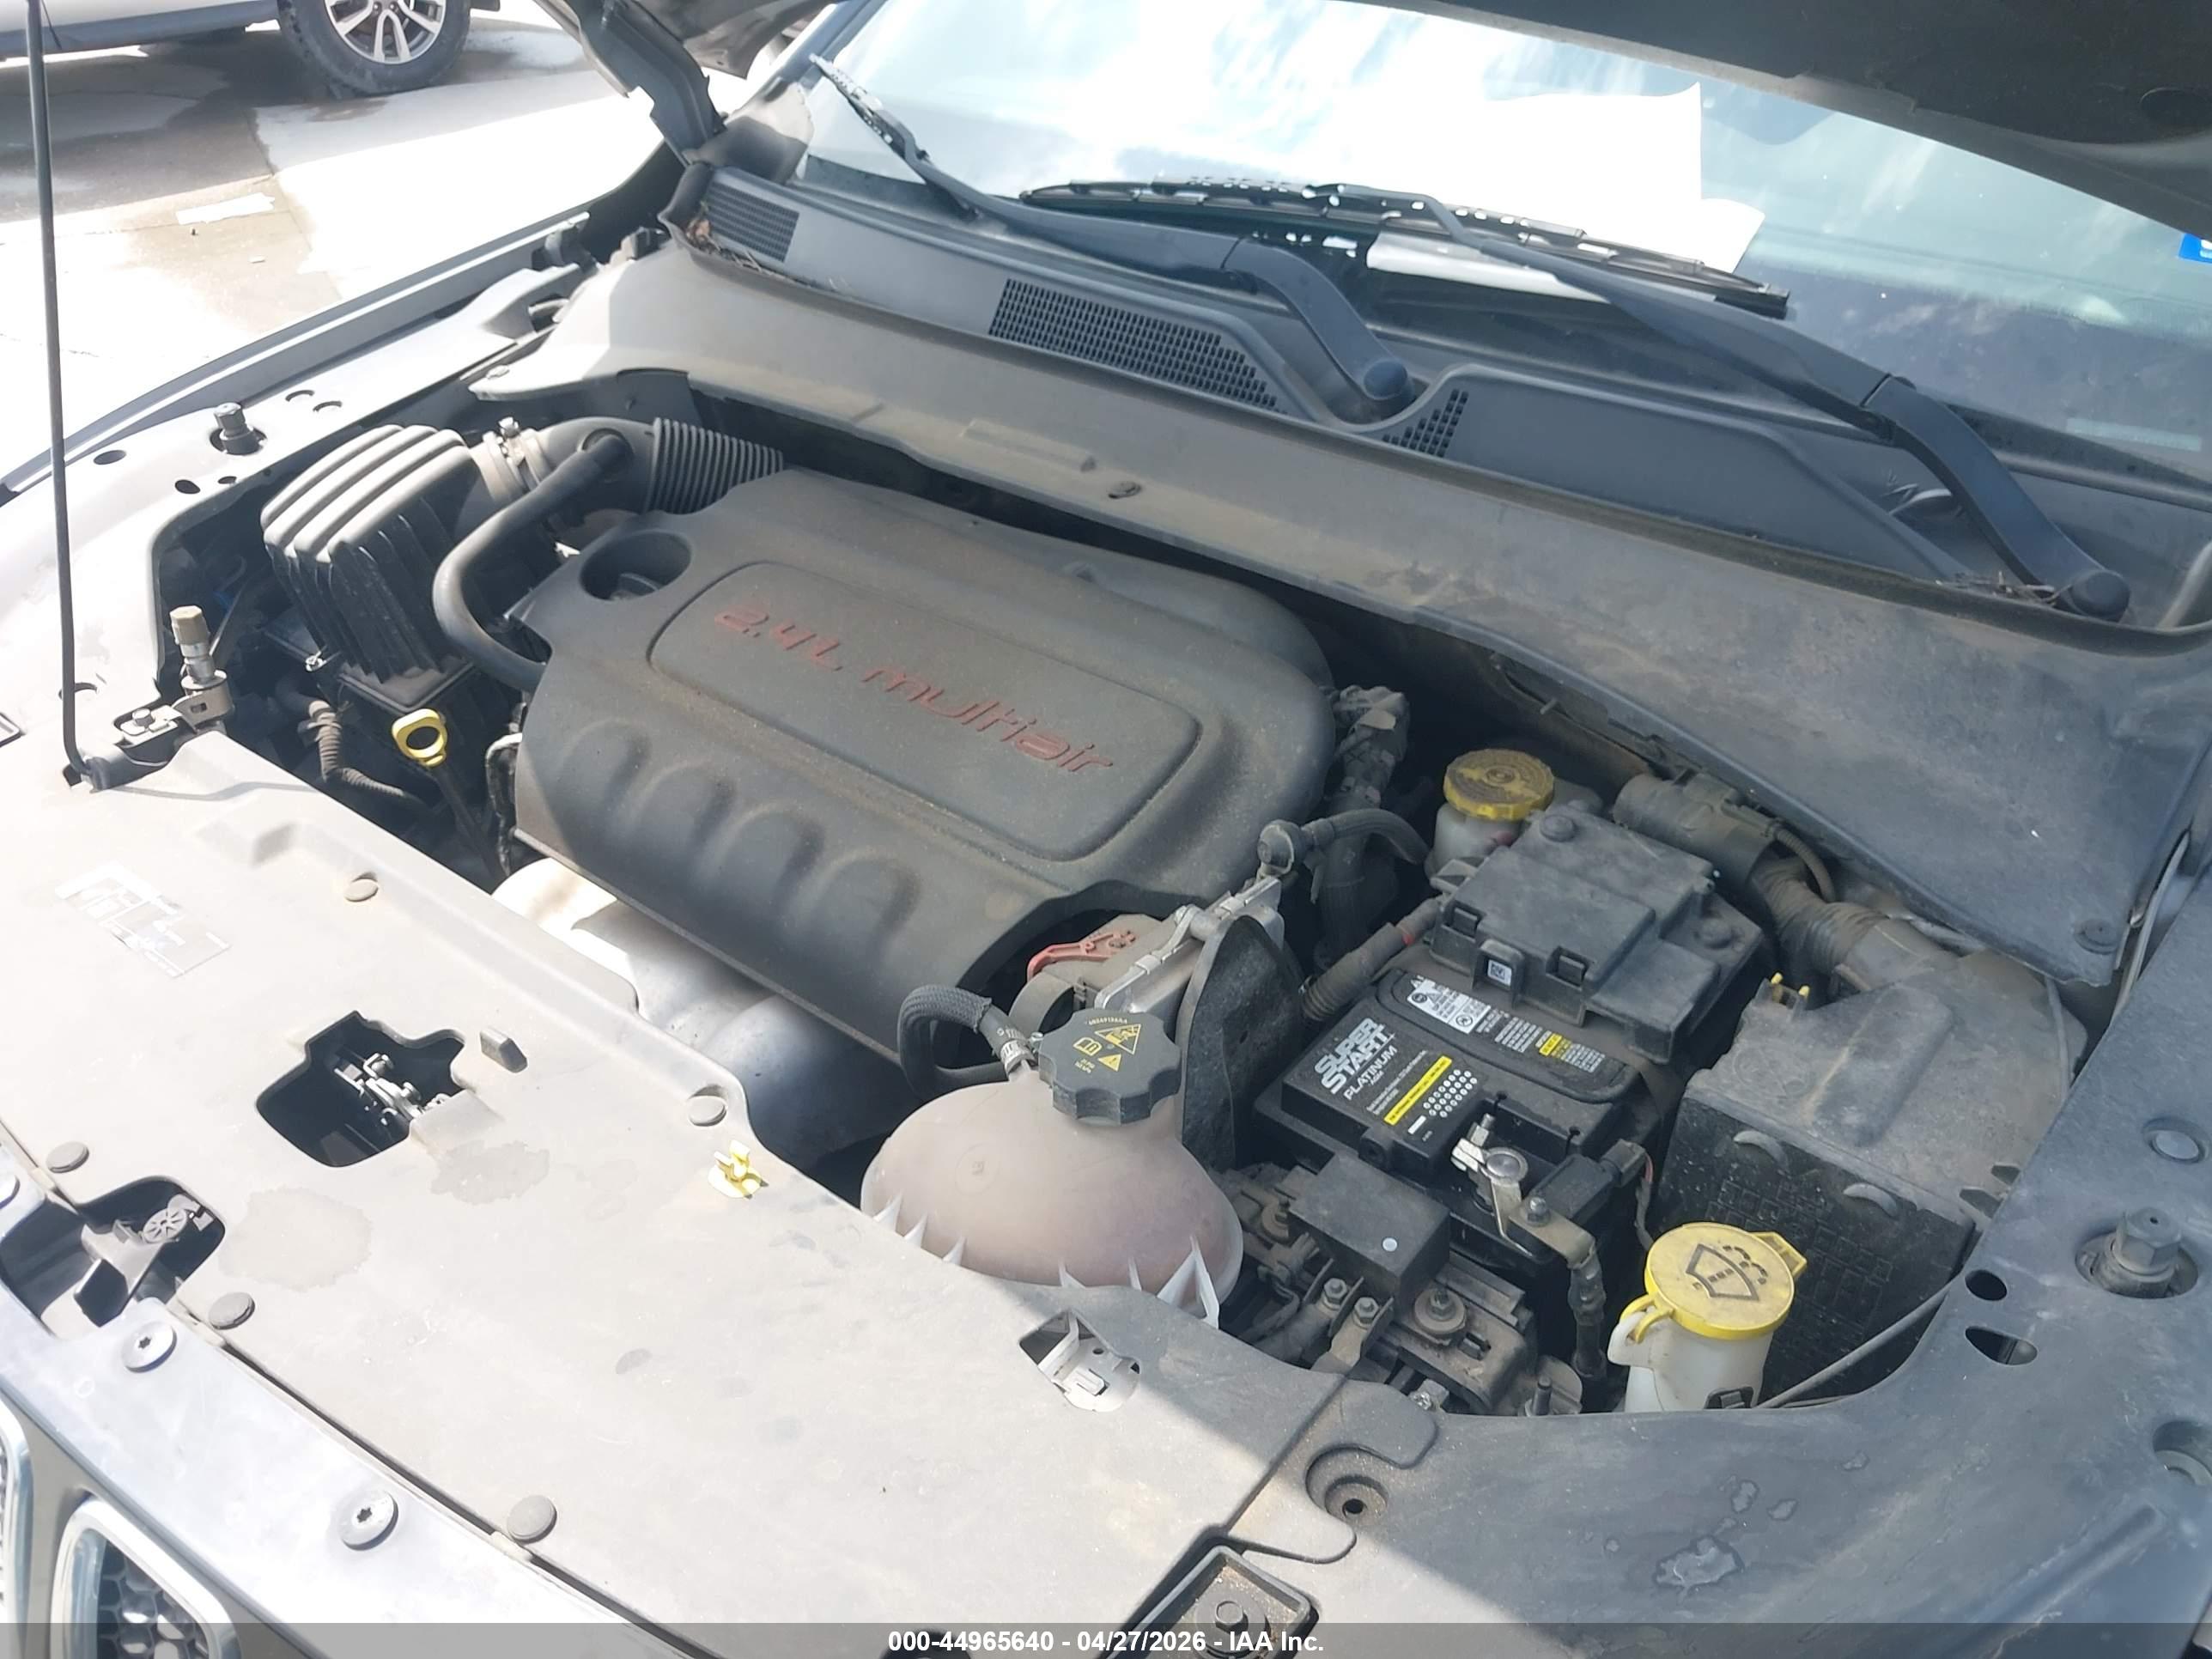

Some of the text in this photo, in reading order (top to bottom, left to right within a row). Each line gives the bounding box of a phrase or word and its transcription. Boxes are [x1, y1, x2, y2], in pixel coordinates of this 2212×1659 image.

[861, 665, 1114, 773] multiair
[1314, 1018, 1379, 1074] SUPER
[1321, 1024, 1389, 1095] START
[1343, 1044, 1398, 1100] PLATINUM
